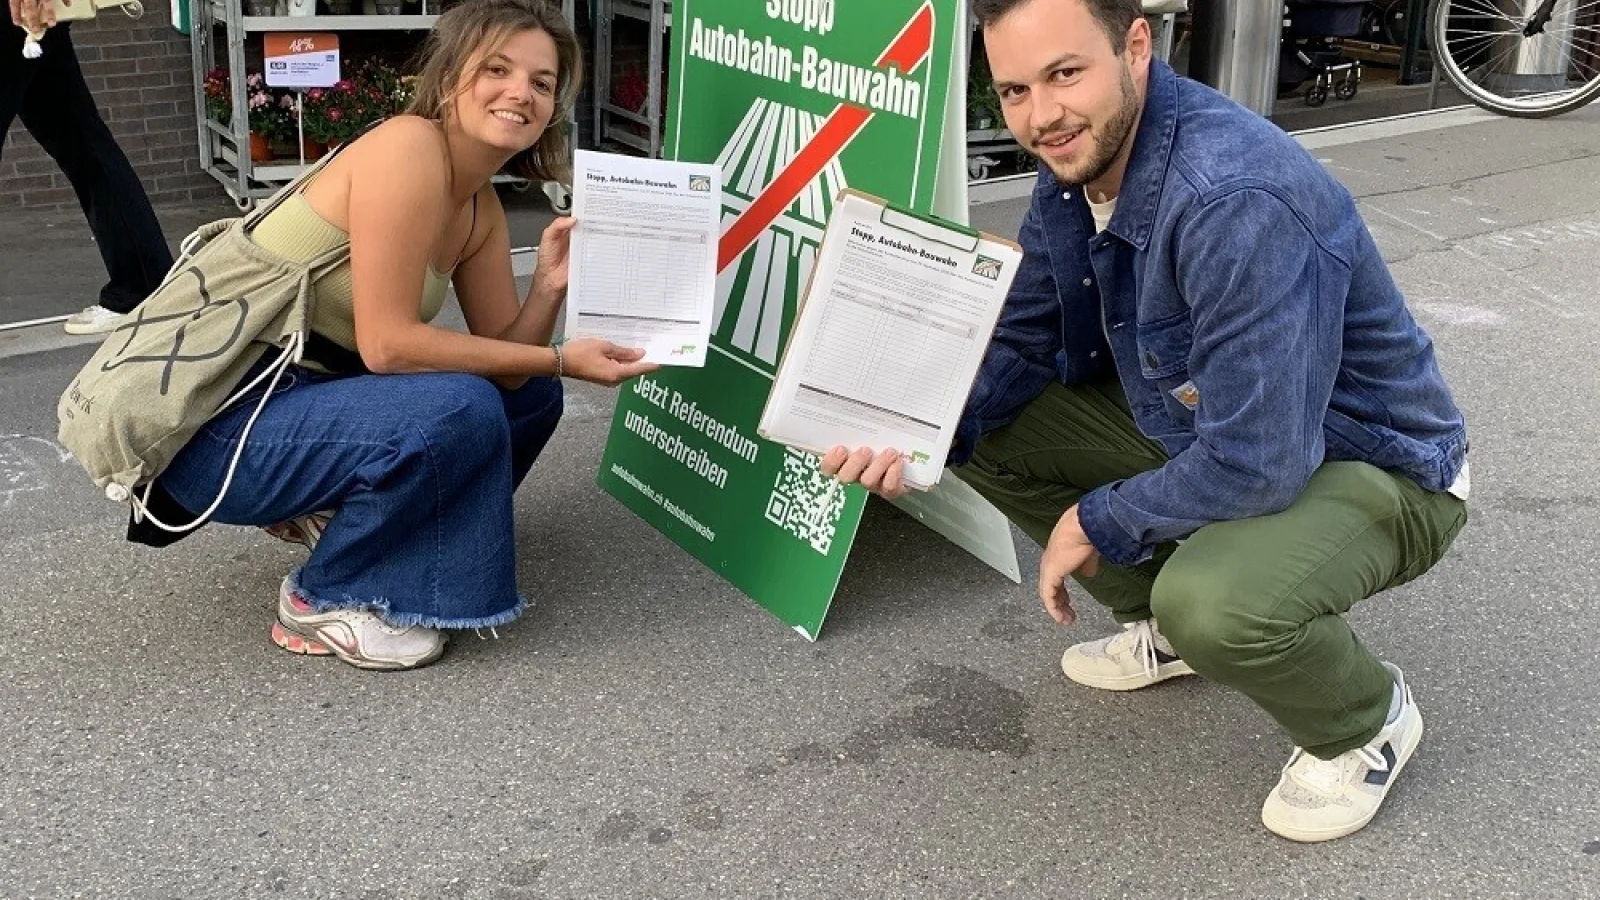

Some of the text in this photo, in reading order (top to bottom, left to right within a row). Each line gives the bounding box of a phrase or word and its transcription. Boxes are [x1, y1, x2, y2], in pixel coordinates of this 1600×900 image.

[689, 17, 921, 119] Autobahn-Bauwahn
[610, 174, 677, 189] Autobahn-Bauwahn
[850, 227, 876, 243] Stopp,
[878, 235, 958, 268] Autobahn-Bauwahn
[624, 410, 728, 489] unterschreiben
[633, 374, 669, 410] Jetzt
[669, 390, 759, 463] Referendum
